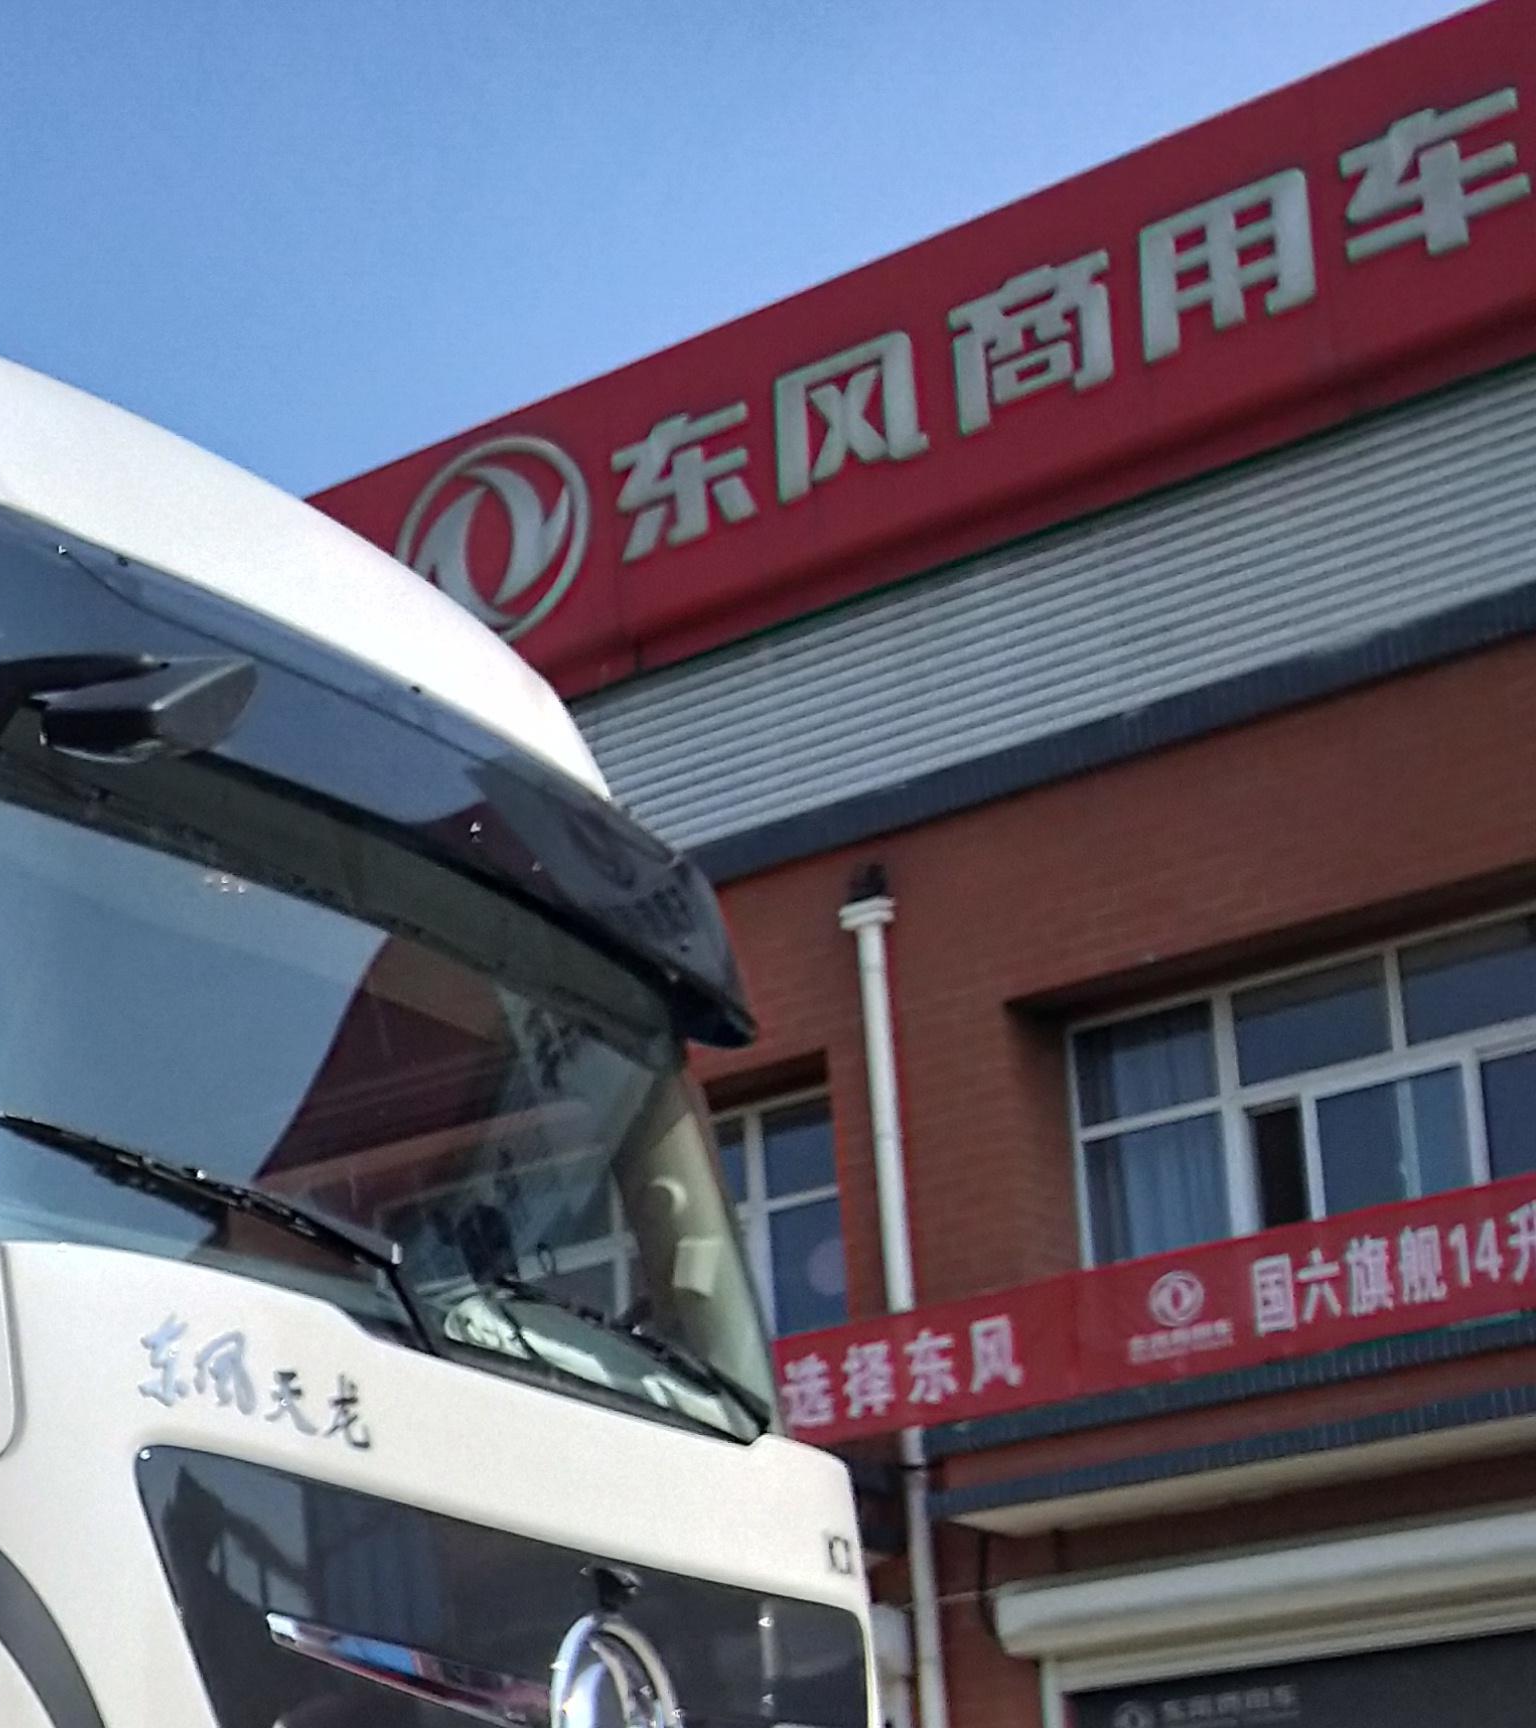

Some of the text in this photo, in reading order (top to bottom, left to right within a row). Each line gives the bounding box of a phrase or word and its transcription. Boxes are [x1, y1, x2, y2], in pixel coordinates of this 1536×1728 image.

[610, 86, 1531, 564] 东风商用车
[137, 1312, 371, 1450] 东风天龙
[781, 1313, 1025, 1427] 选择东风
